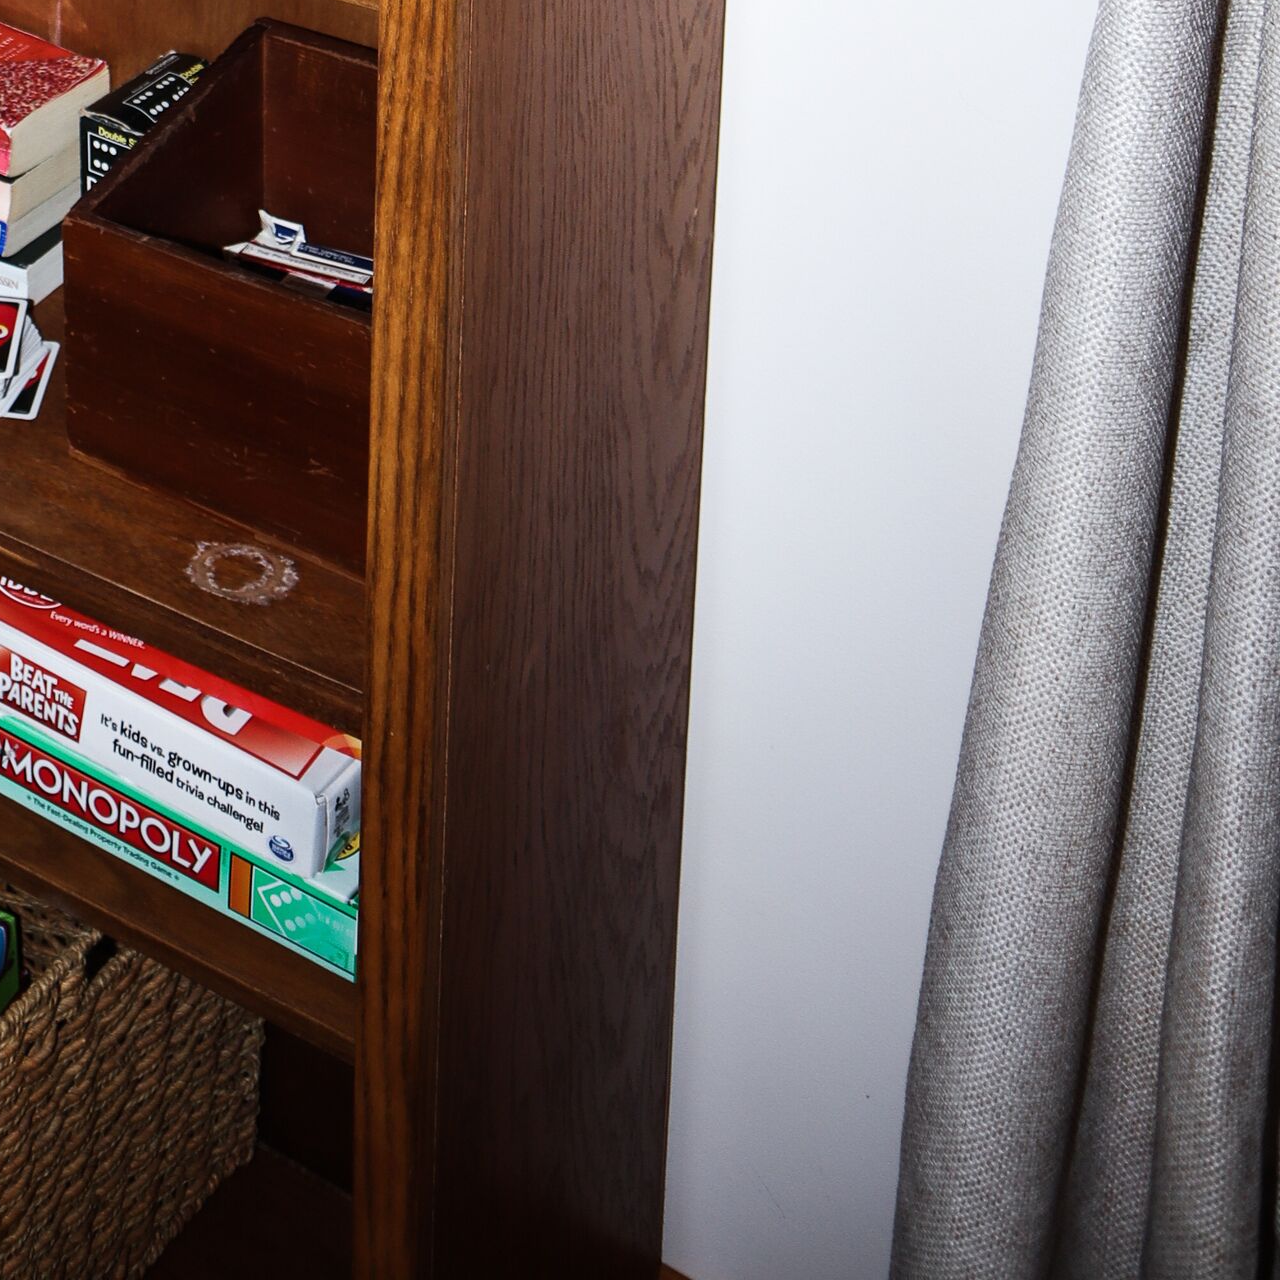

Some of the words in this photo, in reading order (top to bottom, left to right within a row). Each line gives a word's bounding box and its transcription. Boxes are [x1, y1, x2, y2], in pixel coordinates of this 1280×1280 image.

[98, 126, 128, 146] Double
[50, 610, 72, 627] Every
[100, 629, 108, 637] a
[9, 652, 59, 699] BEAT
[53, 689, 75, 709] THE
[1, 738, 213, 875] MONOPOLY
[100, 712, 118, 733] It's
[119, 720, 149, 749] kids
[150, 742, 166, 759] vs.
[168, 750, 244, 801] grown-ups
[245, 790, 257, 808] in
[258, 797, 281, 822] this
[112, 738, 175, 785] fun-filled
[176, 775, 206, 802] trivia
[207, 789, 265, 835] challenge!
[32, 796, 48, 810] The
[89, 825, 123, 853] Property
[122, 844, 150, 868] Trading
[150, 859, 172, 878] Game
